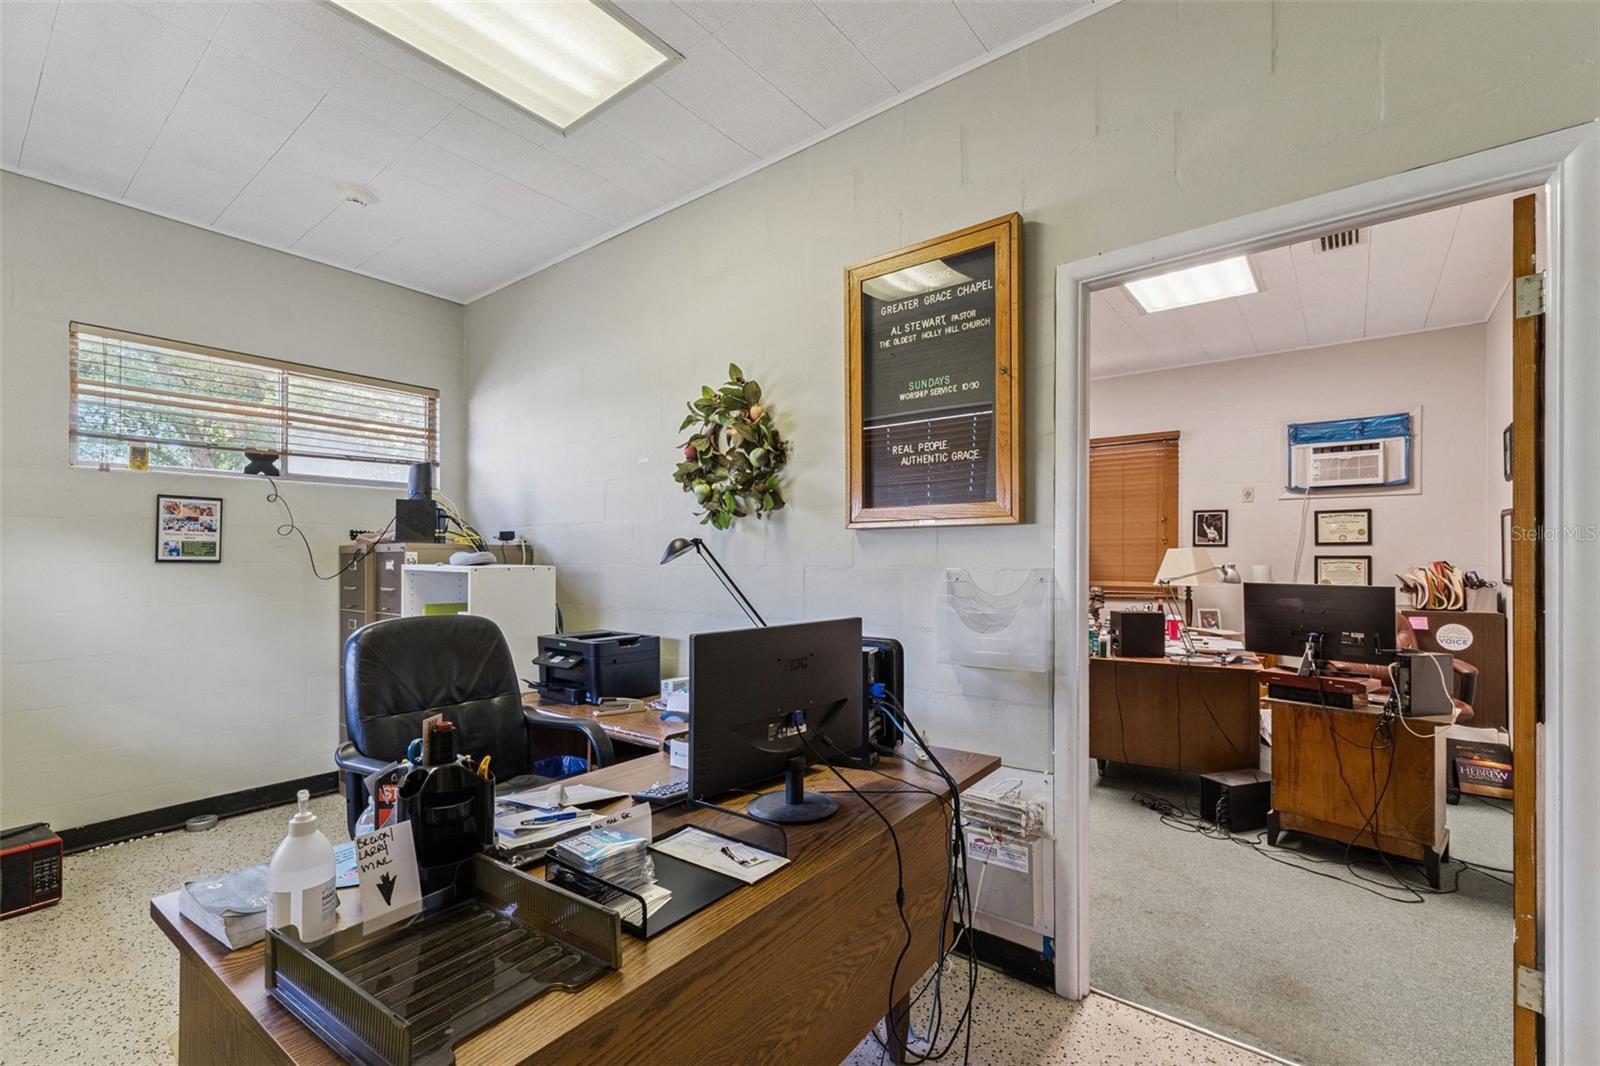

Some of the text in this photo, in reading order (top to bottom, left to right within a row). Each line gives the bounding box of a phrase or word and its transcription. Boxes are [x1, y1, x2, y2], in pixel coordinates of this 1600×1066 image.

[880, 279, 993, 316] GREATER GRACE CHAPEL
[890, 326, 902, 336] AL
[950, 309, 977, 322] PASTOR
[879, 317, 991, 349] THE OLDEST HOLLY HILL CHURCH
[908, 375, 951, 391] SUNDAYS
[898, 390, 929, 401] WORSHIP
[929, 384, 958, 397] SERVICE
[892, 444, 915, 455] REAL
[900, 452, 949, 466] AUTHENTIC
[1438, 637, 1469, 647] VOICE
[1459, 765, 1509, 780] HEBREW
